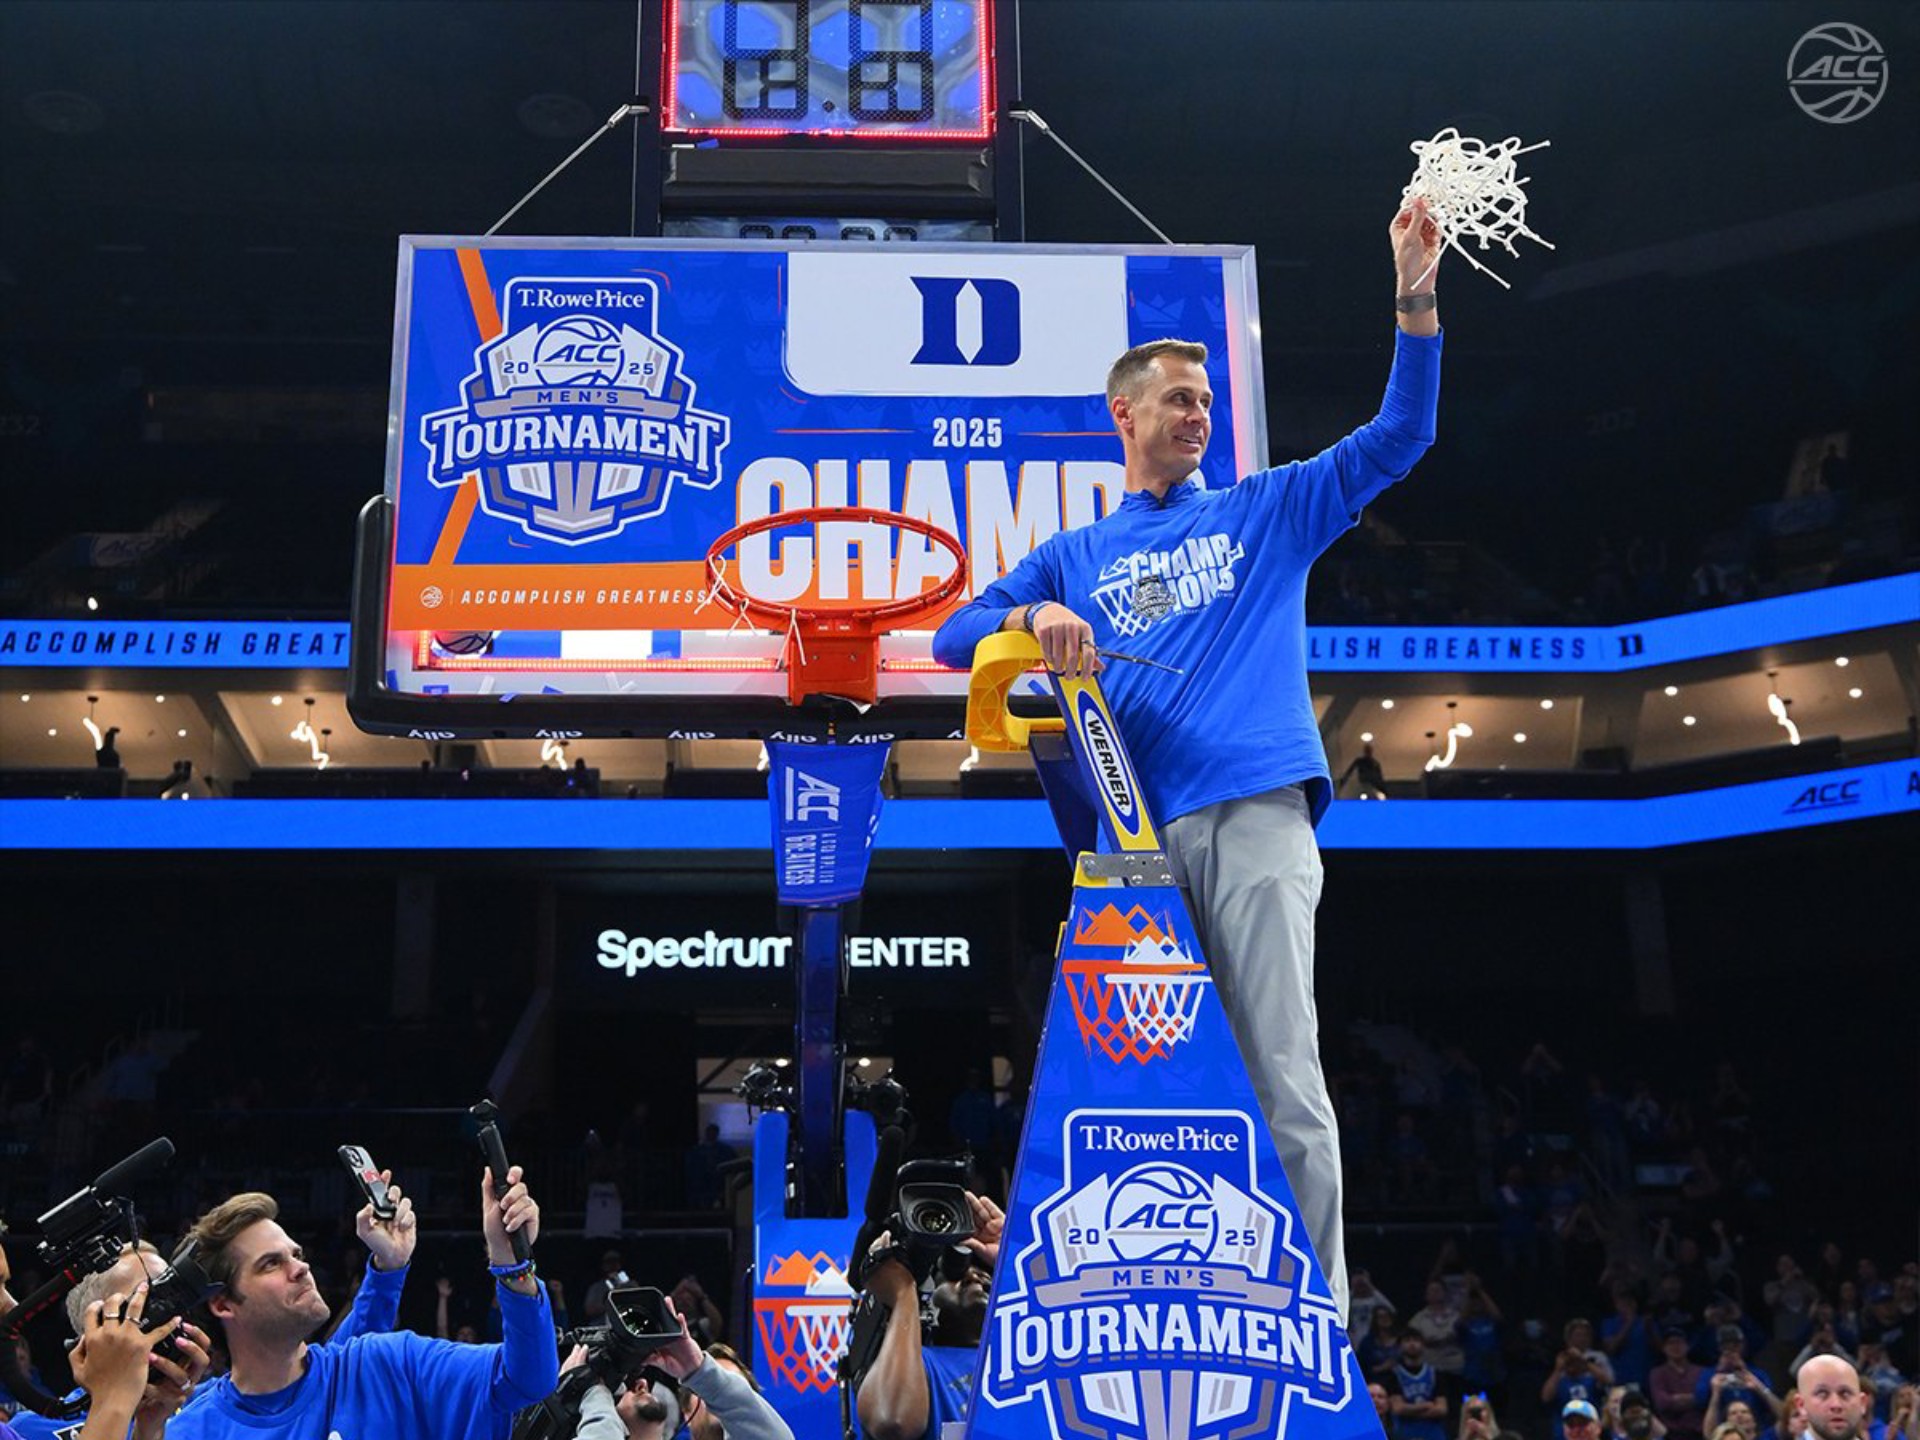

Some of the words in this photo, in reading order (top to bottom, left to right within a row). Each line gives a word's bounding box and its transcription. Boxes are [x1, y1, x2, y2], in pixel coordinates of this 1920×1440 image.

[544, 344, 622, 362] ACC
[503, 362, 529, 374] 20
[629, 363, 654, 375] 25
[536, 391, 619, 404] MEN'S
[933, 417, 1003, 448] 2025
[431, 414, 720, 471] TOURNAMENT
[738, 457, 1206, 601] CHAMP
[461, 589, 586, 604] ACCOMPLISH
[596, 589, 707, 604] GREATNESS
[1, 631, 222, 655] ACCOMPLISH
[242, 632, 347, 656] GREAT
[1403, 637, 1586, 659] GREATNESS
[408, 728, 456, 740] ally
[535, 728, 583, 740] ally
[668, 730, 716, 741] ally
[770, 731, 817, 743] ally
[848, 732, 895, 744] ally
[1087, 718, 1131, 808] WERNER
[797, 770, 840, 821] ACC
[1789, 779, 1862, 807] ACC
[844, 937, 970, 967] ENTER
[1117, 1203, 1216, 1229] ACC
[1068, 1228, 1100, 1244] 20
[1225, 1230, 1256, 1246] 25
[1112, 1269, 1215, 1287] MEN'S
[994, 1303, 1341, 1385] TOURNAMENT
